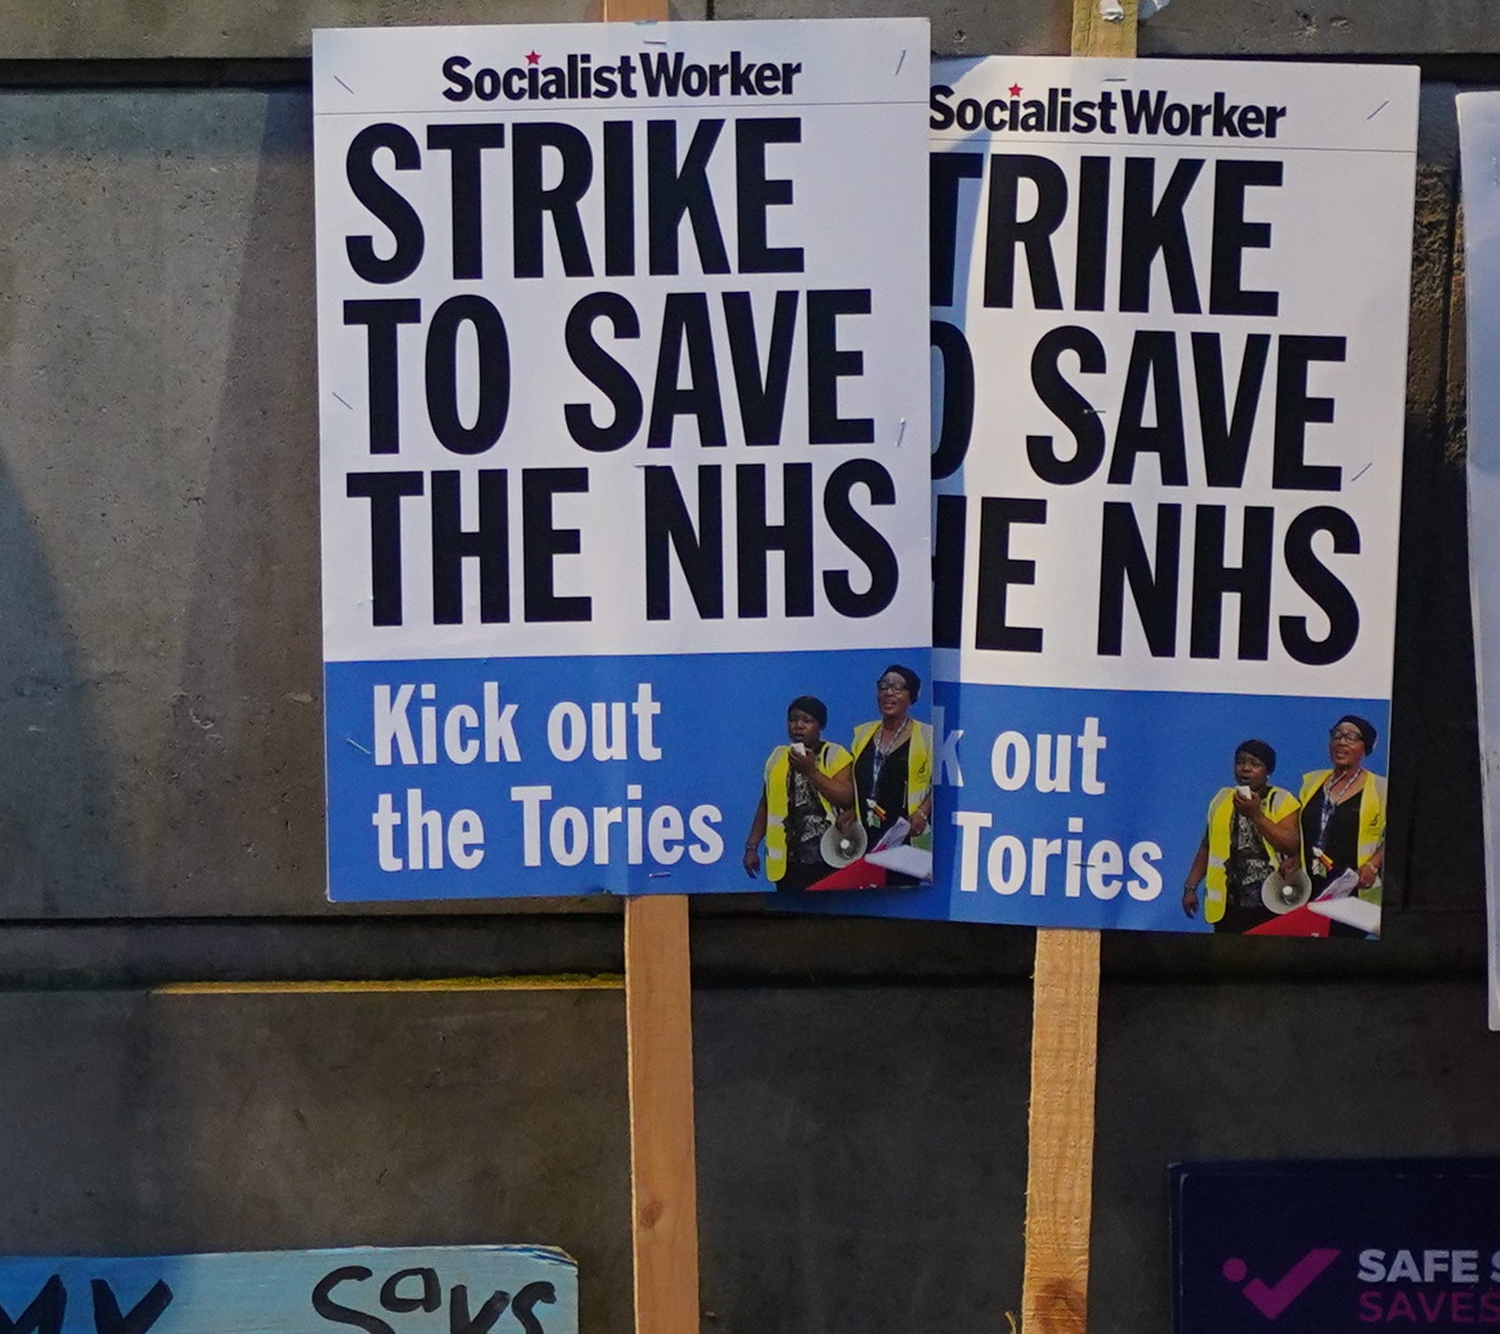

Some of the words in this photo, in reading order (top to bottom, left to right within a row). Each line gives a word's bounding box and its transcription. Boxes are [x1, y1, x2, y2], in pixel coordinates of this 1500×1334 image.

[442, 51, 637, 101] Socialist
[639, 52, 802, 97] Worker
[345, 117, 805, 284] STRIKE
[343, 294, 511, 456] TO
[563, 289, 874, 453] SAVE
[1026, 325, 1347, 492] SAVE
[346, 467, 592, 627] THE
[645, 458, 899, 620] NHS
[1098, 501, 1361, 666] NHS
[373, 682, 521, 766] Kick
[548, 683, 662, 762] out
[372, 789, 484, 872] the
[511, 785, 724, 867] Tories
[952, 811, 1163, 902] Tories
[1358, 1249, 1480, 1284] SAFE
